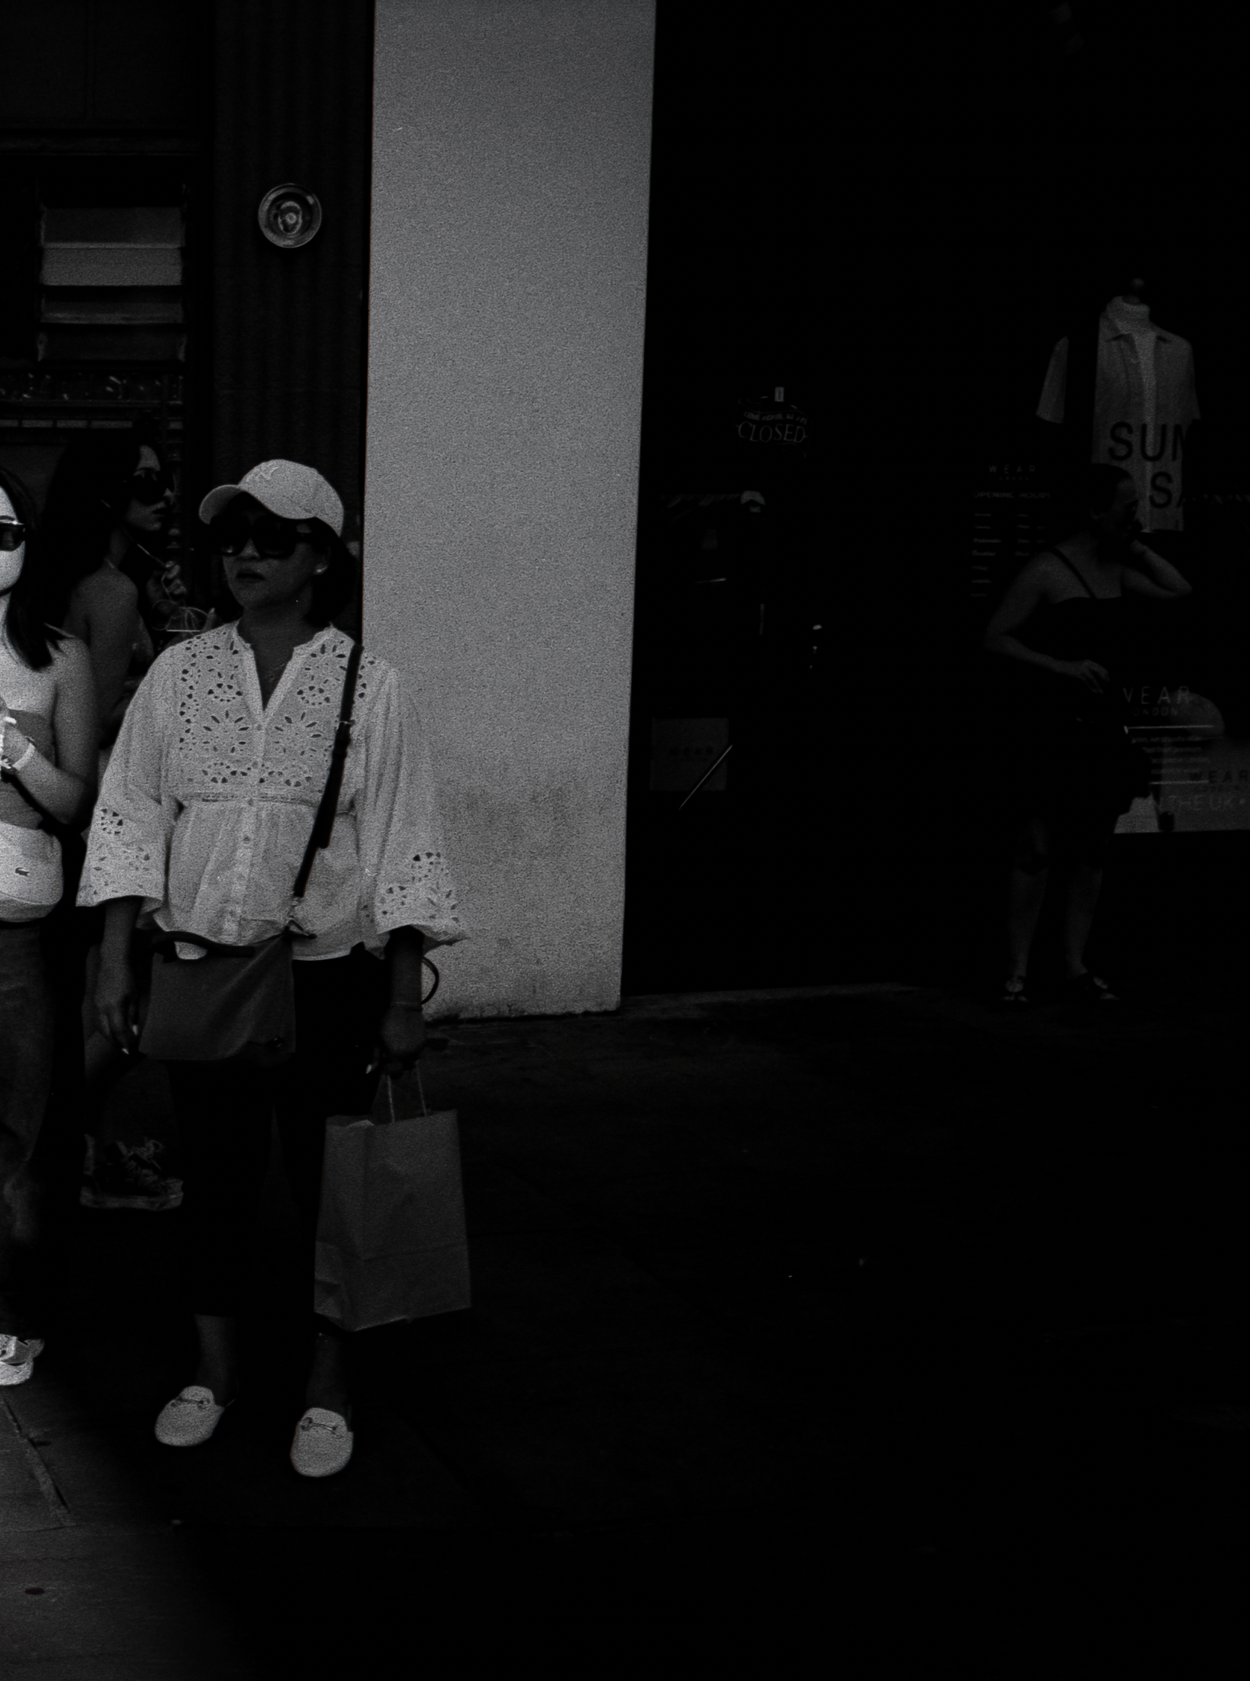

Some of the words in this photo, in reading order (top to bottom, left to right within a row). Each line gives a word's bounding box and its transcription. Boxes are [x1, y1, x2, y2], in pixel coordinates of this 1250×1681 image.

[737, 420, 807, 443] CLOSED
[988, 464, 1036, 474] WEAR
[973, 491, 1016, 499] OPENING
